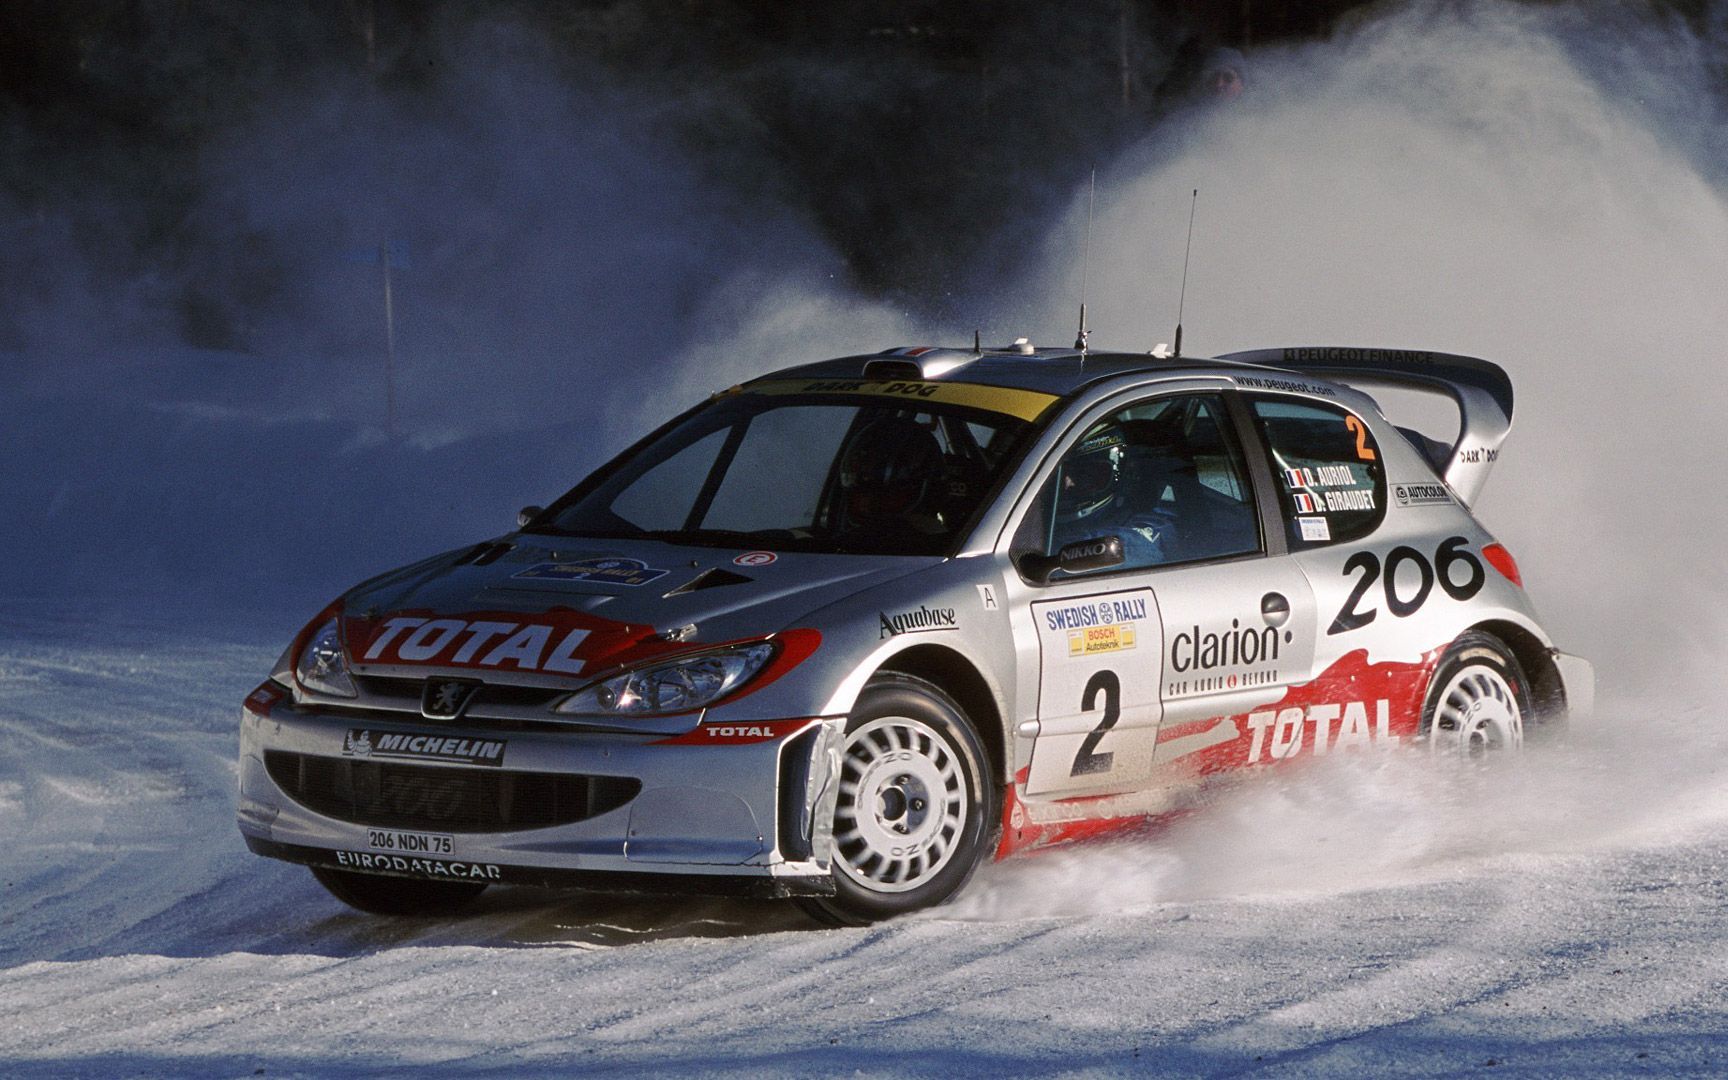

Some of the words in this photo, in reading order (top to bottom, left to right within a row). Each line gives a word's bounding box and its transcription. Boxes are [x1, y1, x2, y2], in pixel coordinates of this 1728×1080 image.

[1299, 349, 1367, 363] PEUGEOT
[1370, 350, 1434, 365] FINANCE
[883, 382, 940, 397] DOG
[1233, 375, 1336, 397] www.peugeot.com
[1345, 415, 1376, 460] 2
[1319, 465, 1356, 485] AURIOL
[1324, 490, 1376, 511] GIRAUDET
[1060, 543, 1106, 563] NIKKO
[984, 587, 997, 608] A
[1327, 536, 1485, 636] 206
[879, 605, 956, 639] Aquabase
[1046, 603, 1099, 631] SWEDISH
[1114, 598, 1147, 622] RALLY
[363, 617, 592, 674] TOTAL
[1088, 628, 1115, 640] BOSCH
[1169, 680, 1188, 696] CAR
[1194, 676, 1223, 693] AUDIO
[1242, 670, 1278, 686] BEYOND
[706, 727, 774, 737] TOTAL
[1070, 669, 1120, 777] 2
[1247, 698, 1401, 764] TOTAL
[377, 734, 504, 758] MICHELIN
[369, 831, 394, 849] 206
[398, 833, 429, 851] NDN
[433, 836, 452, 853] 75
[336, 850, 501, 880] EURODATACAR
